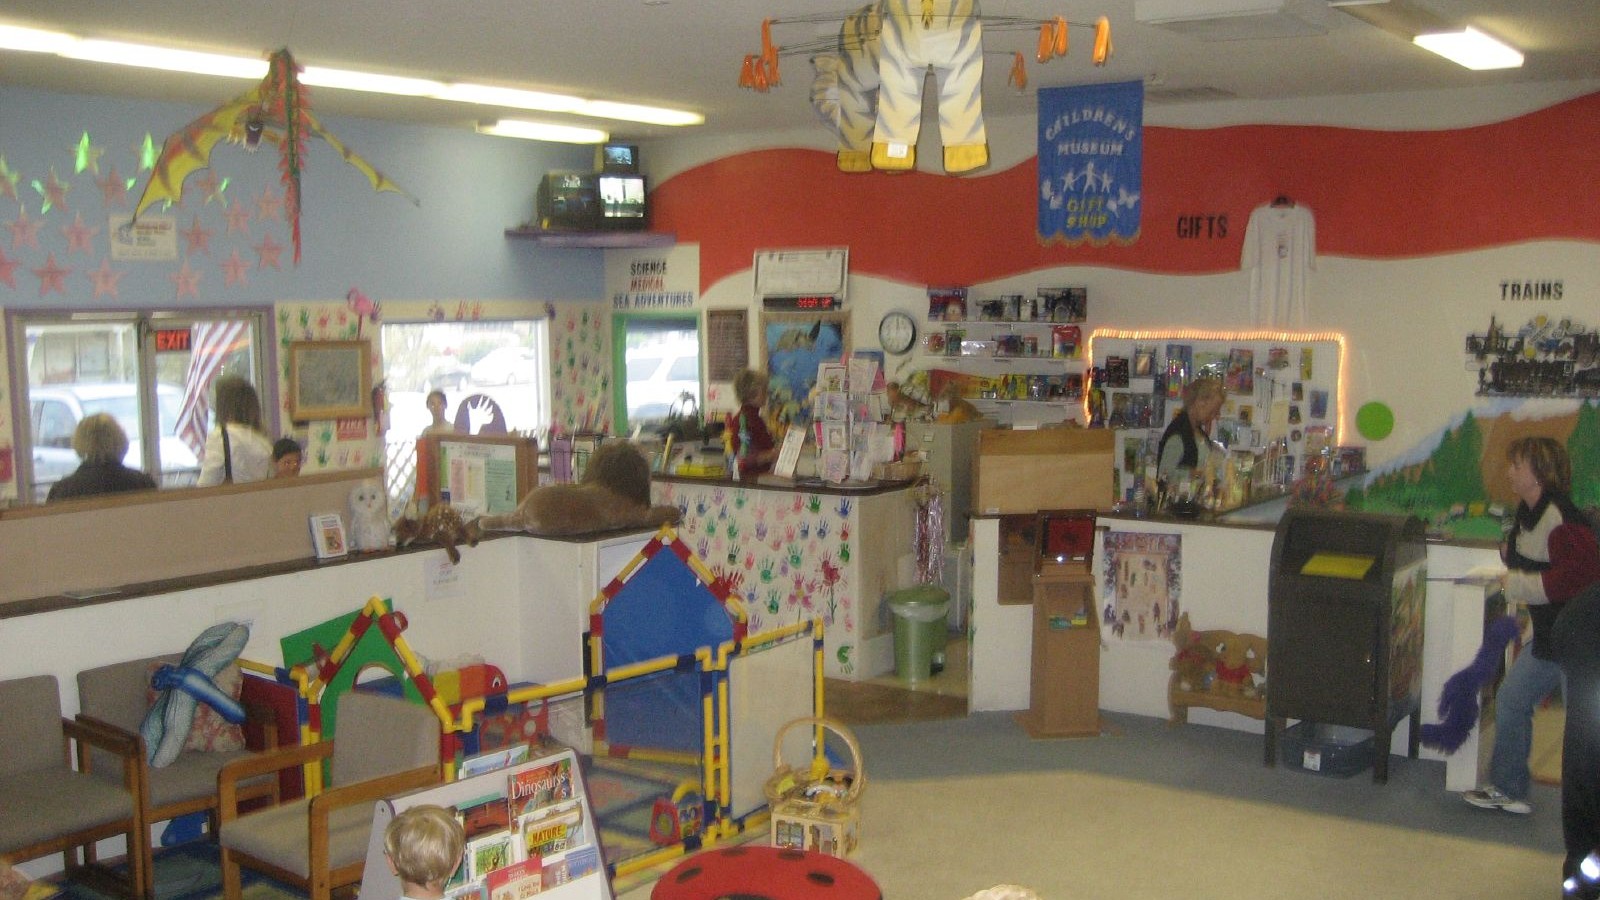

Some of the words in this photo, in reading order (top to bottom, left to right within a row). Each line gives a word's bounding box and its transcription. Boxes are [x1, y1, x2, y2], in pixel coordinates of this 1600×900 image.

[1057, 140, 1124, 156] MUSEUM
[1066, 196, 1104, 213] GIFT
[1066, 213, 1108, 229] SHOP
[1177, 213, 1228, 239] GIFTS
[630, 261, 667, 276] SCIENCE
[630, 278, 664, 292] MEDICAL
[1499, 281, 1564, 301] TRAINS
[613, 294, 630, 309] SEA
[635, 292, 694, 308] ADVENTURES
[157, 330, 189, 350] EXIT
[511, 774, 563, 800] Dinosaurs
[532, 825, 563, 842] NATURE
